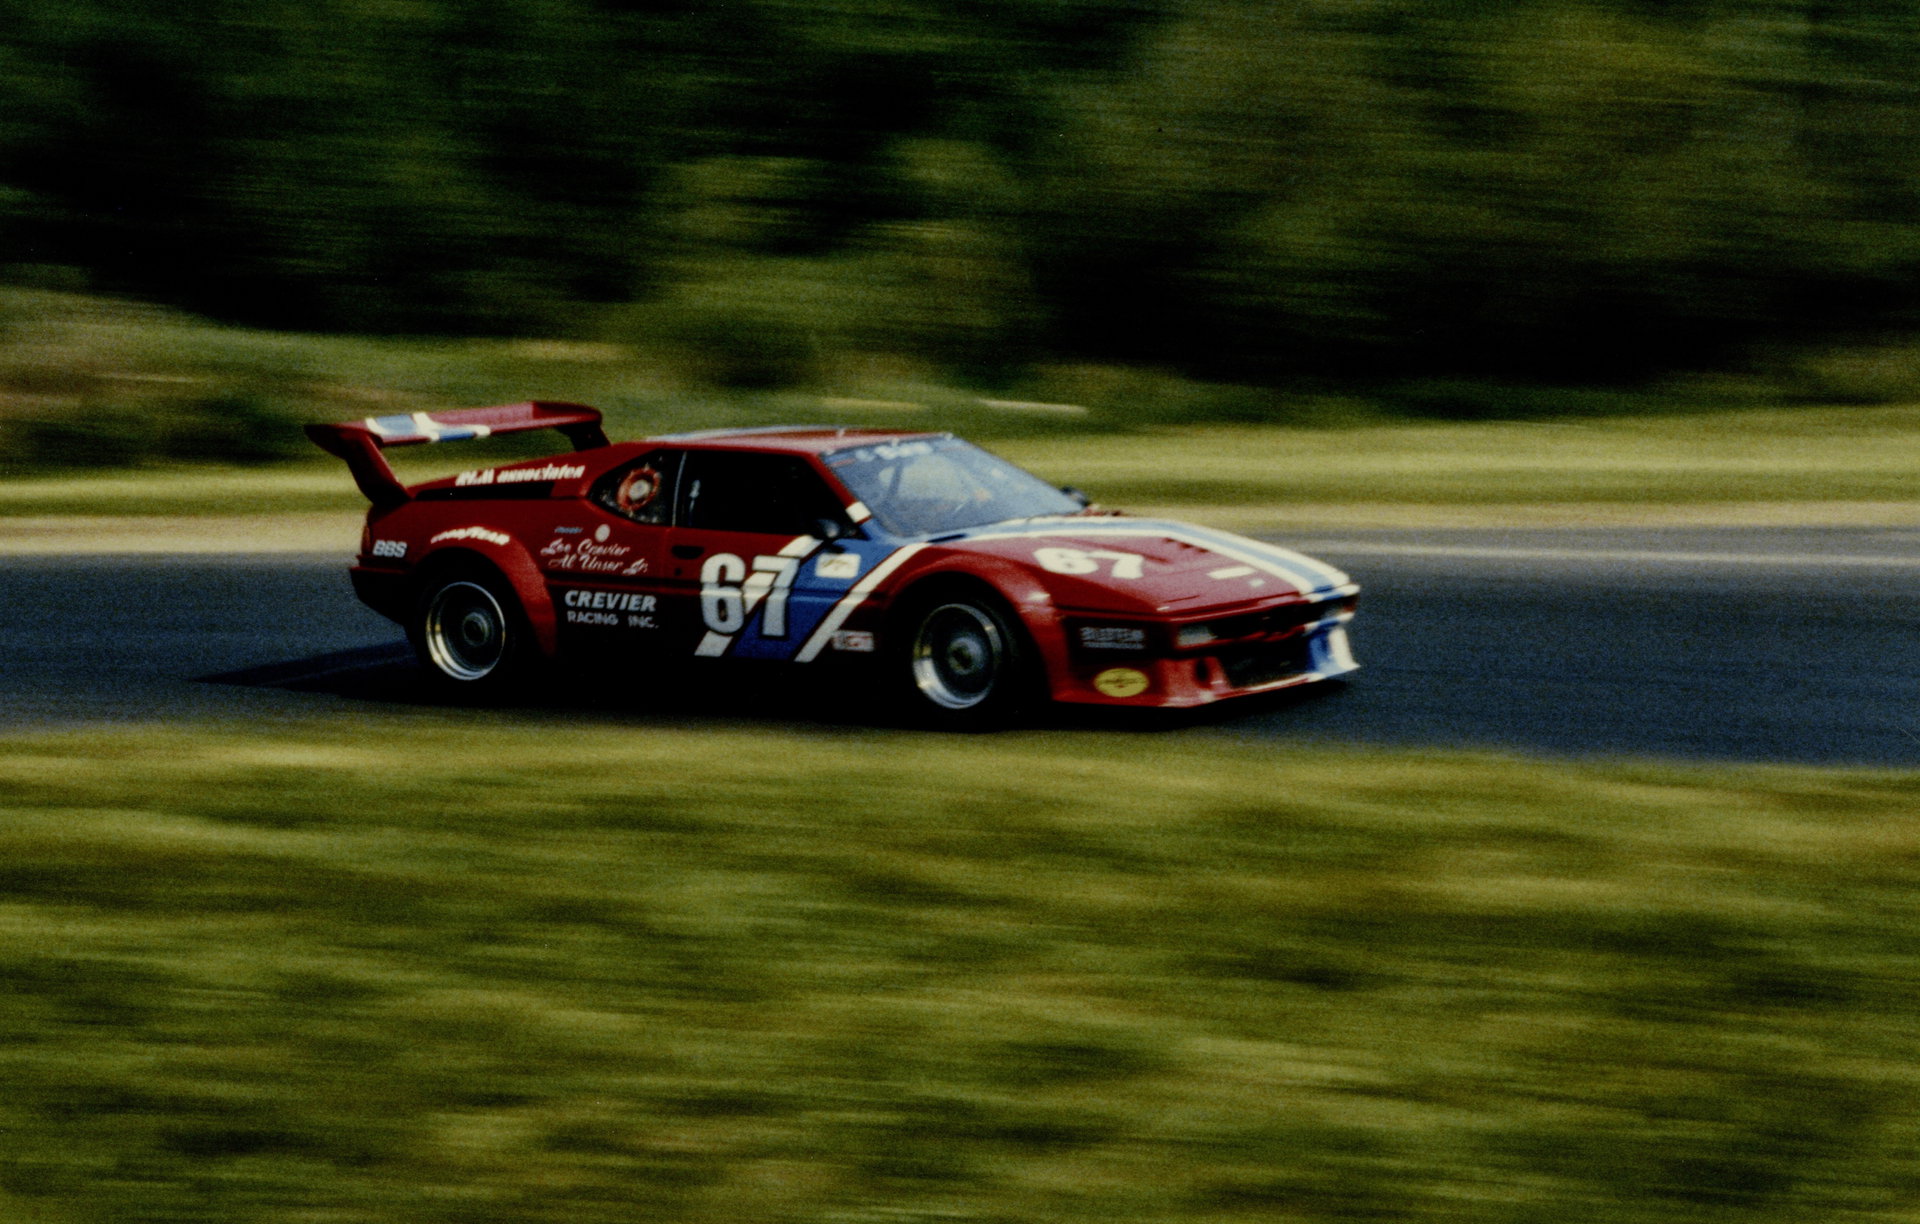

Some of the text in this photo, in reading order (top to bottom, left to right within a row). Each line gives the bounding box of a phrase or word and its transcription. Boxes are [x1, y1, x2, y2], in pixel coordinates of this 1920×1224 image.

[497, 464, 586, 483] associates
[372, 539, 407, 558] BBS
[577, 538, 631, 556] Crevier
[547, 554, 577, 568] Al
[579, 554, 623, 571] Unser
[1033, 547, 1146, 580] 67
[564, 590, 657, 612] CREVIER
[700, 553, 800, 637] 67
[567, 610, 619, 625] RACING
